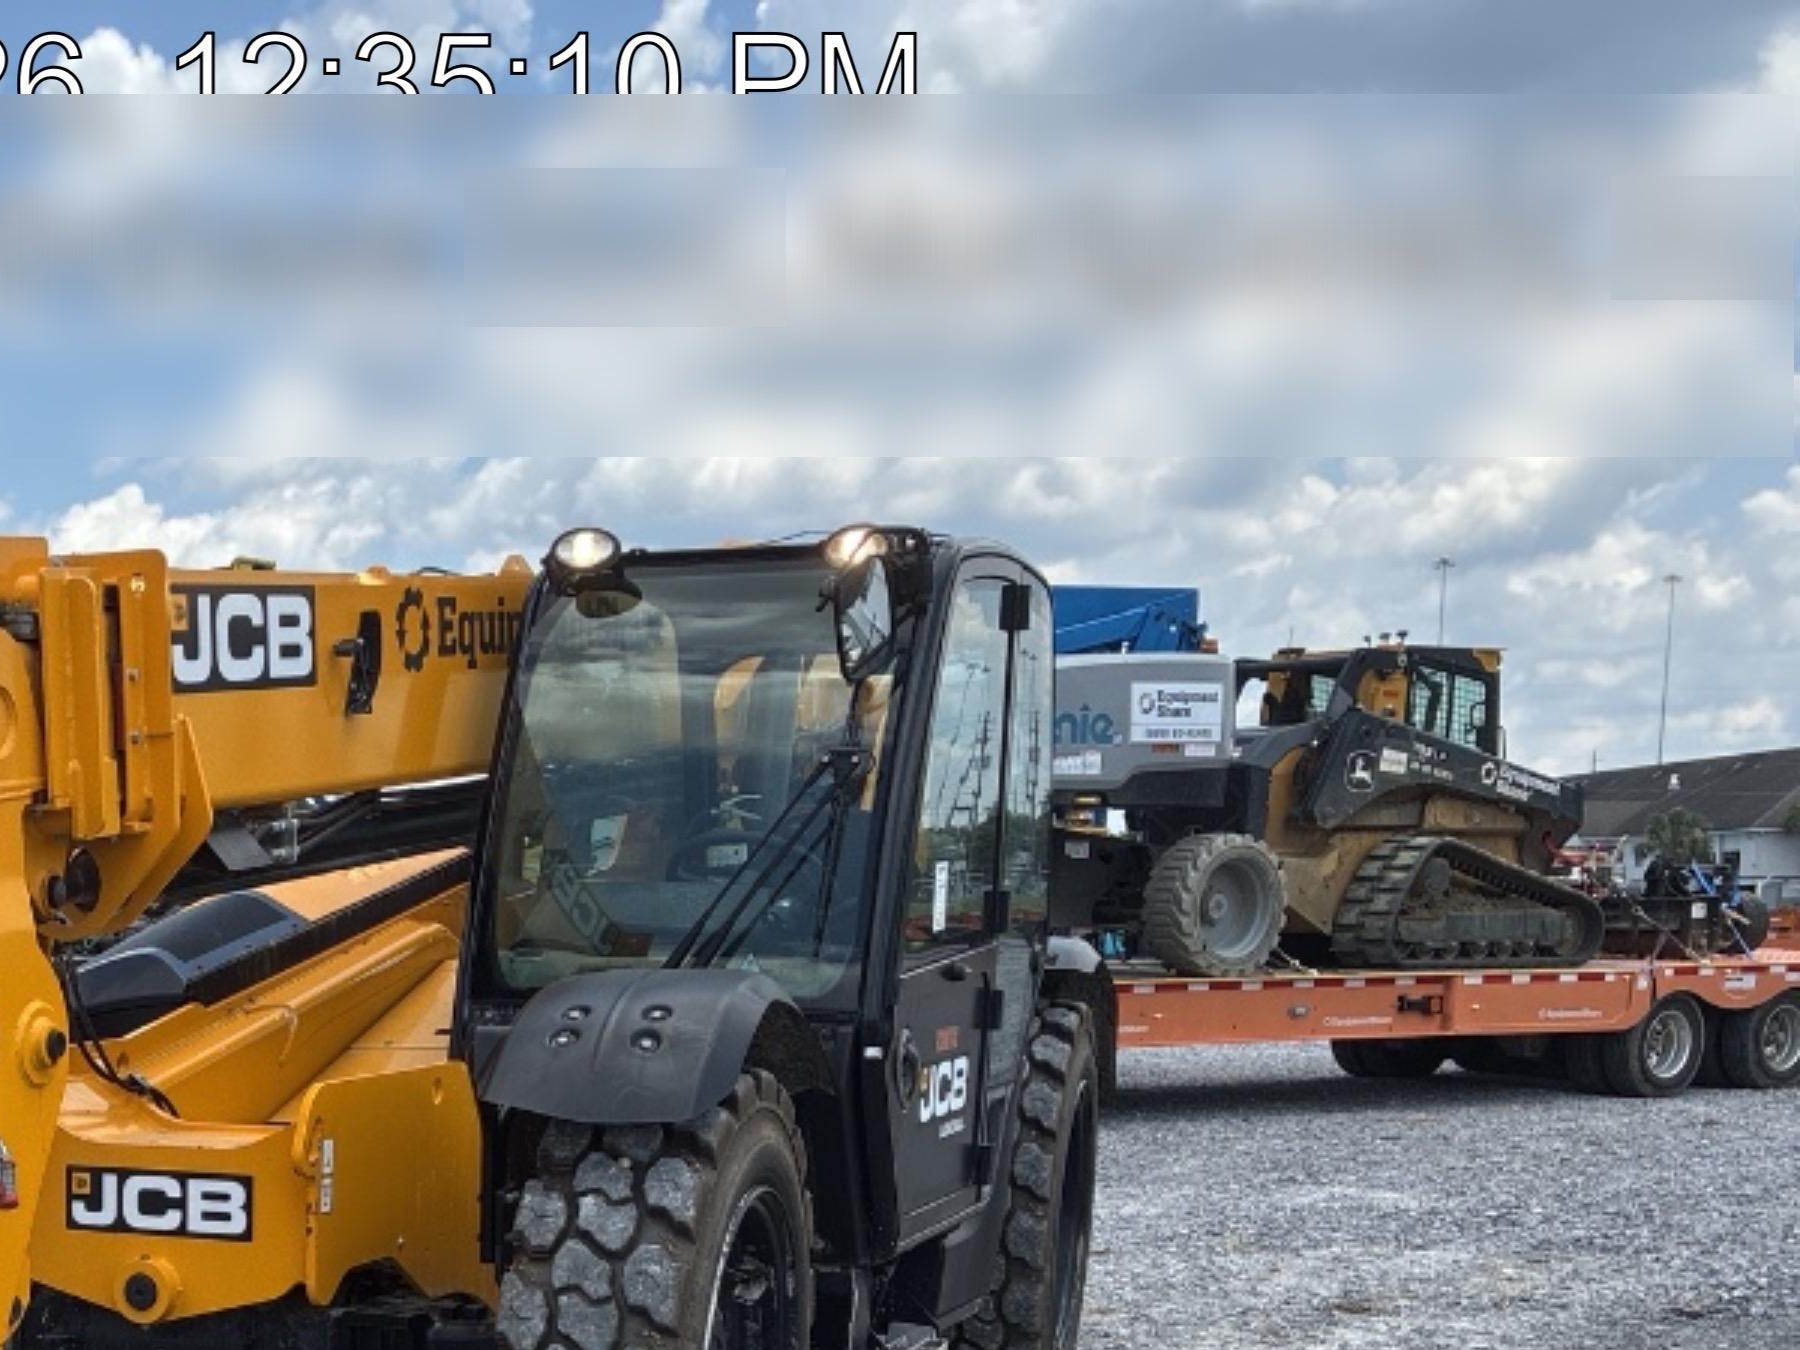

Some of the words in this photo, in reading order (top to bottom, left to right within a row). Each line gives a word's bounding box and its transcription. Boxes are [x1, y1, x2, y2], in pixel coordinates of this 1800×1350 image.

[172, 593, 314, 684] JCB
[920, 1056, 969, 1123] JCB
[72, 1173, 247, 1234] JCB
